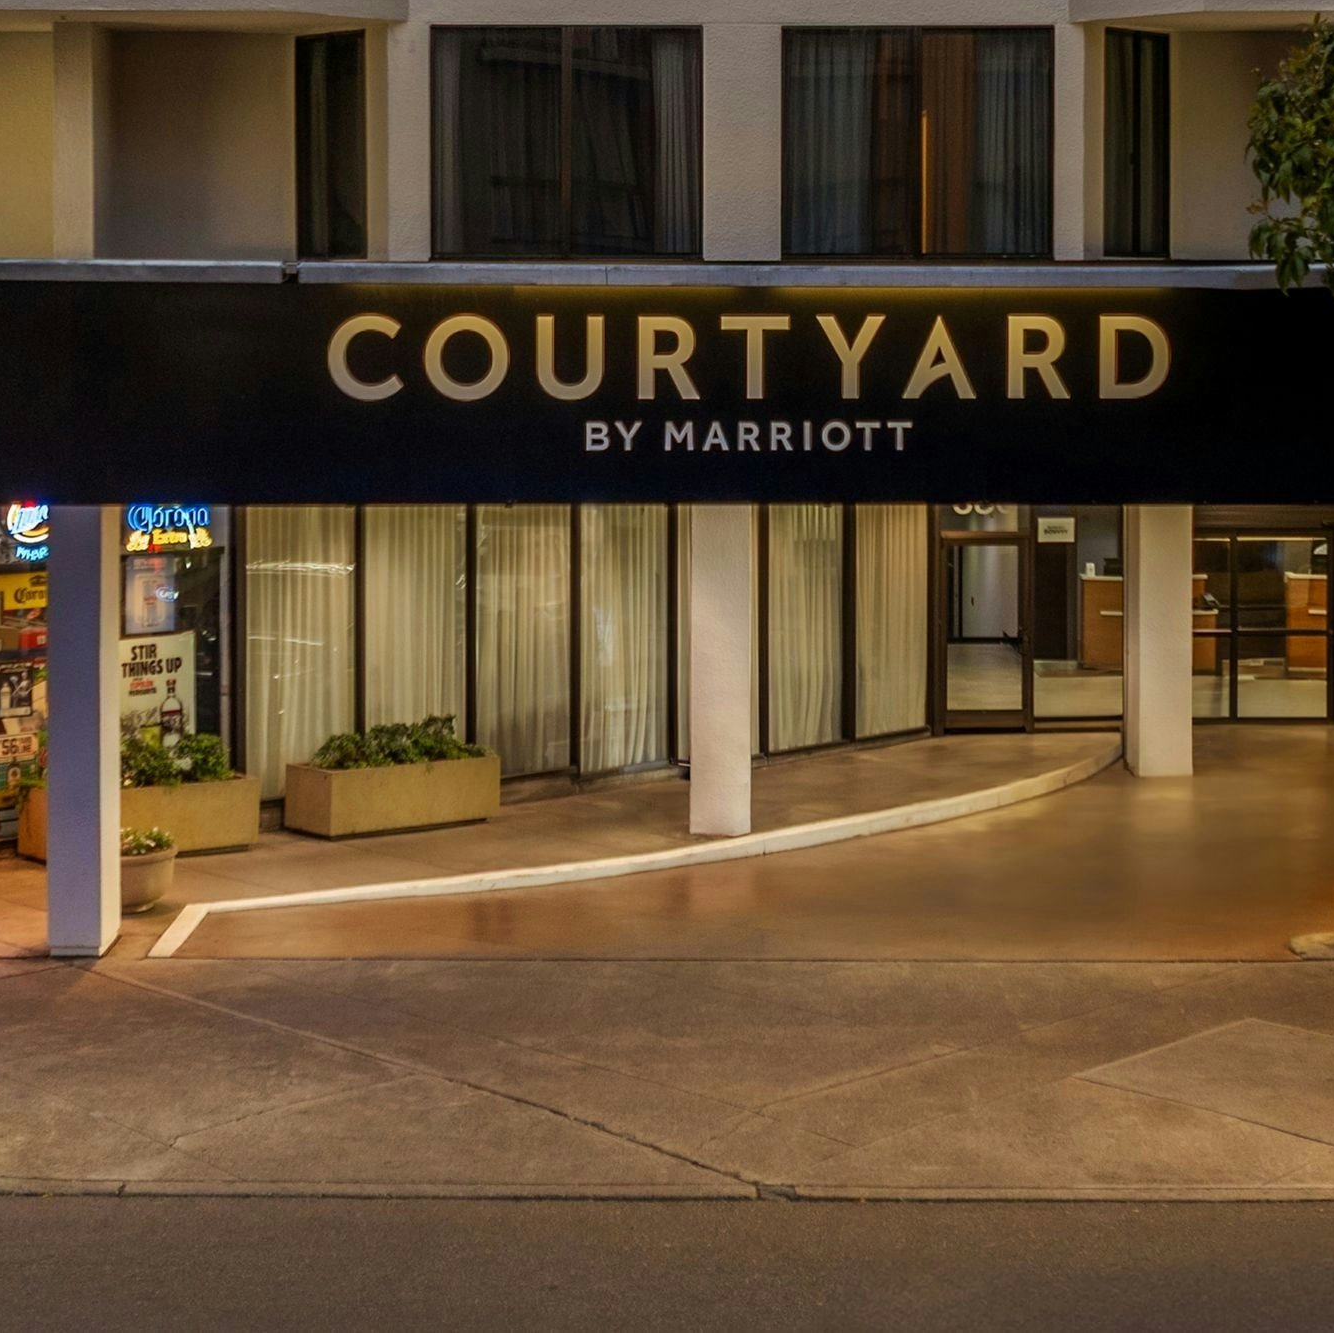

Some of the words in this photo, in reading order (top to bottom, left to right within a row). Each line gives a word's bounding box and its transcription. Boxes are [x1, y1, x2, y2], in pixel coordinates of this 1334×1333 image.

[326, 312, 1172, 402] COURTYARD
[585, 421, 642, 452] BY
[664, 421, 913, 452] MARRIOTT
[128, 505, 210, 533] Corona
[131, 643, 157, 661] STIR
[121, 659, 163, 678] THINGS
[165, 657, 182, 674] UP
